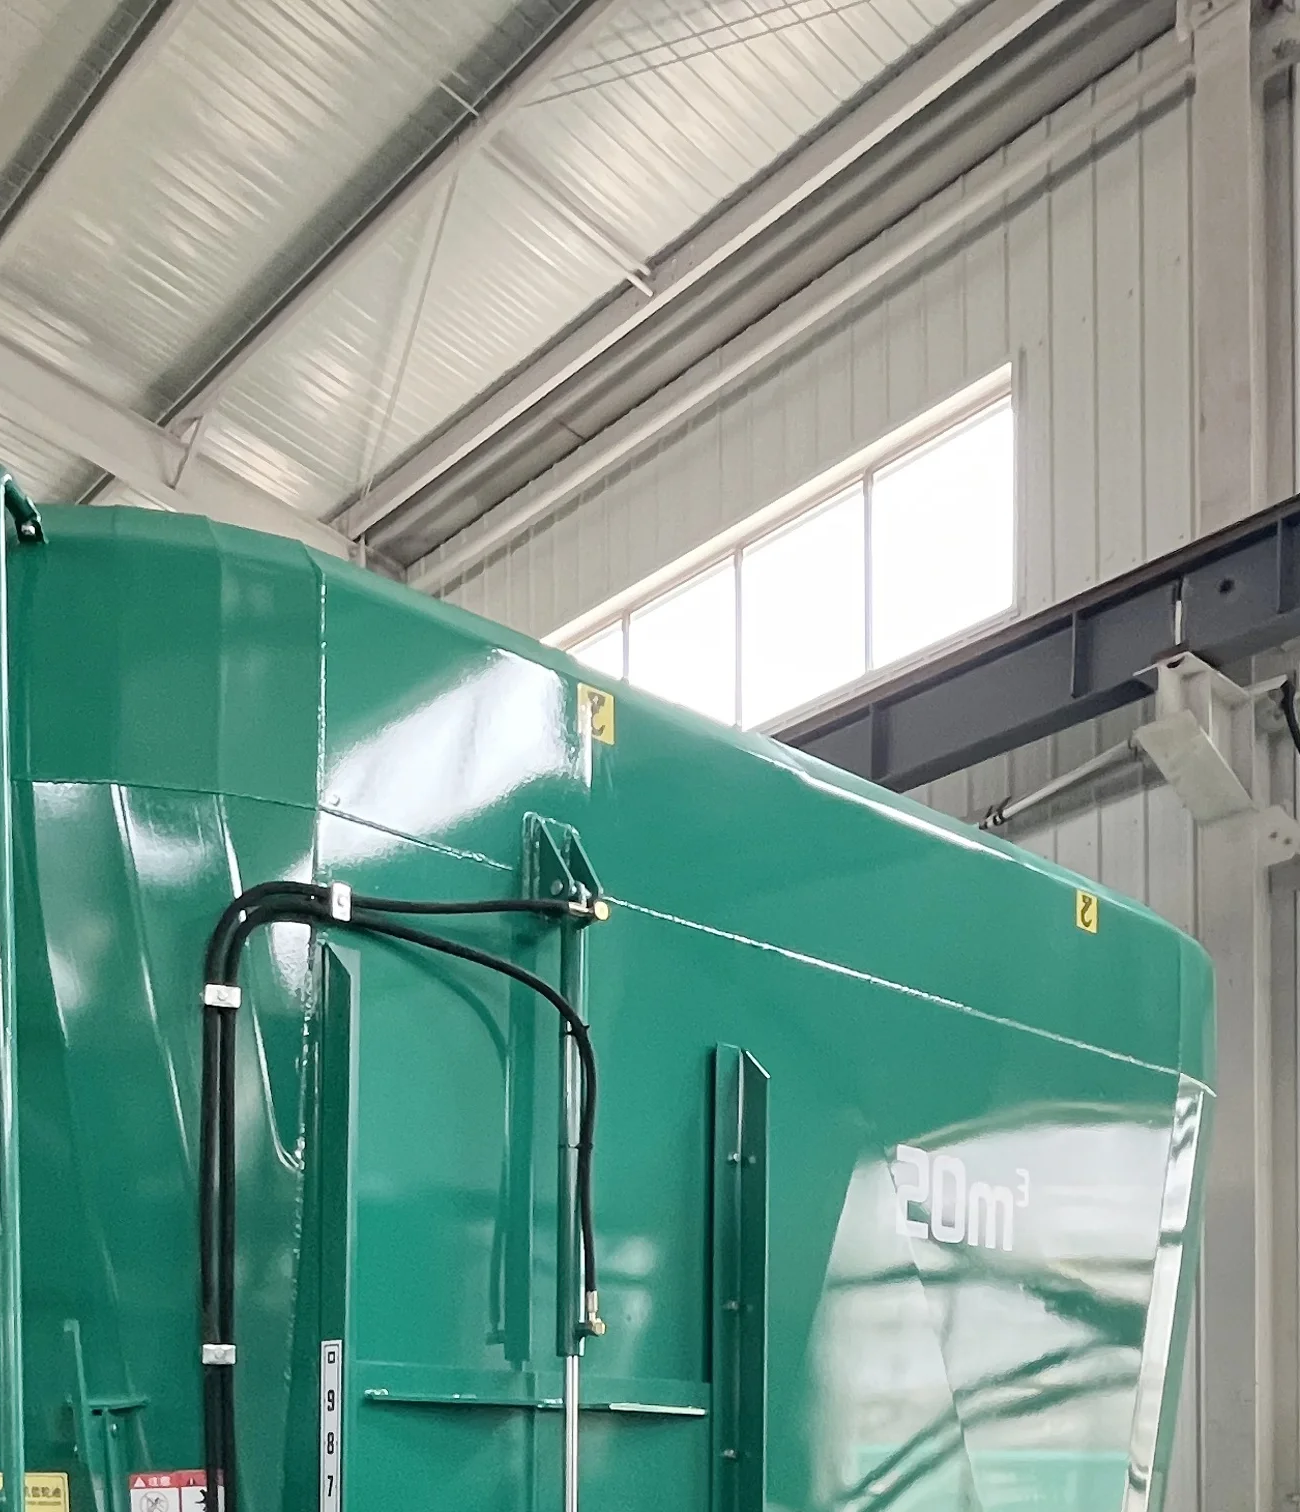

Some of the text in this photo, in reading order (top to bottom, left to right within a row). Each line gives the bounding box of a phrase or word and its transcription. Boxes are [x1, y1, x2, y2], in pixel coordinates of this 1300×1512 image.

[327, 1389, 335, 1412] 9
[327, 1432, 334, 1455] 8
[327, 1475, 334, 1497] 7
